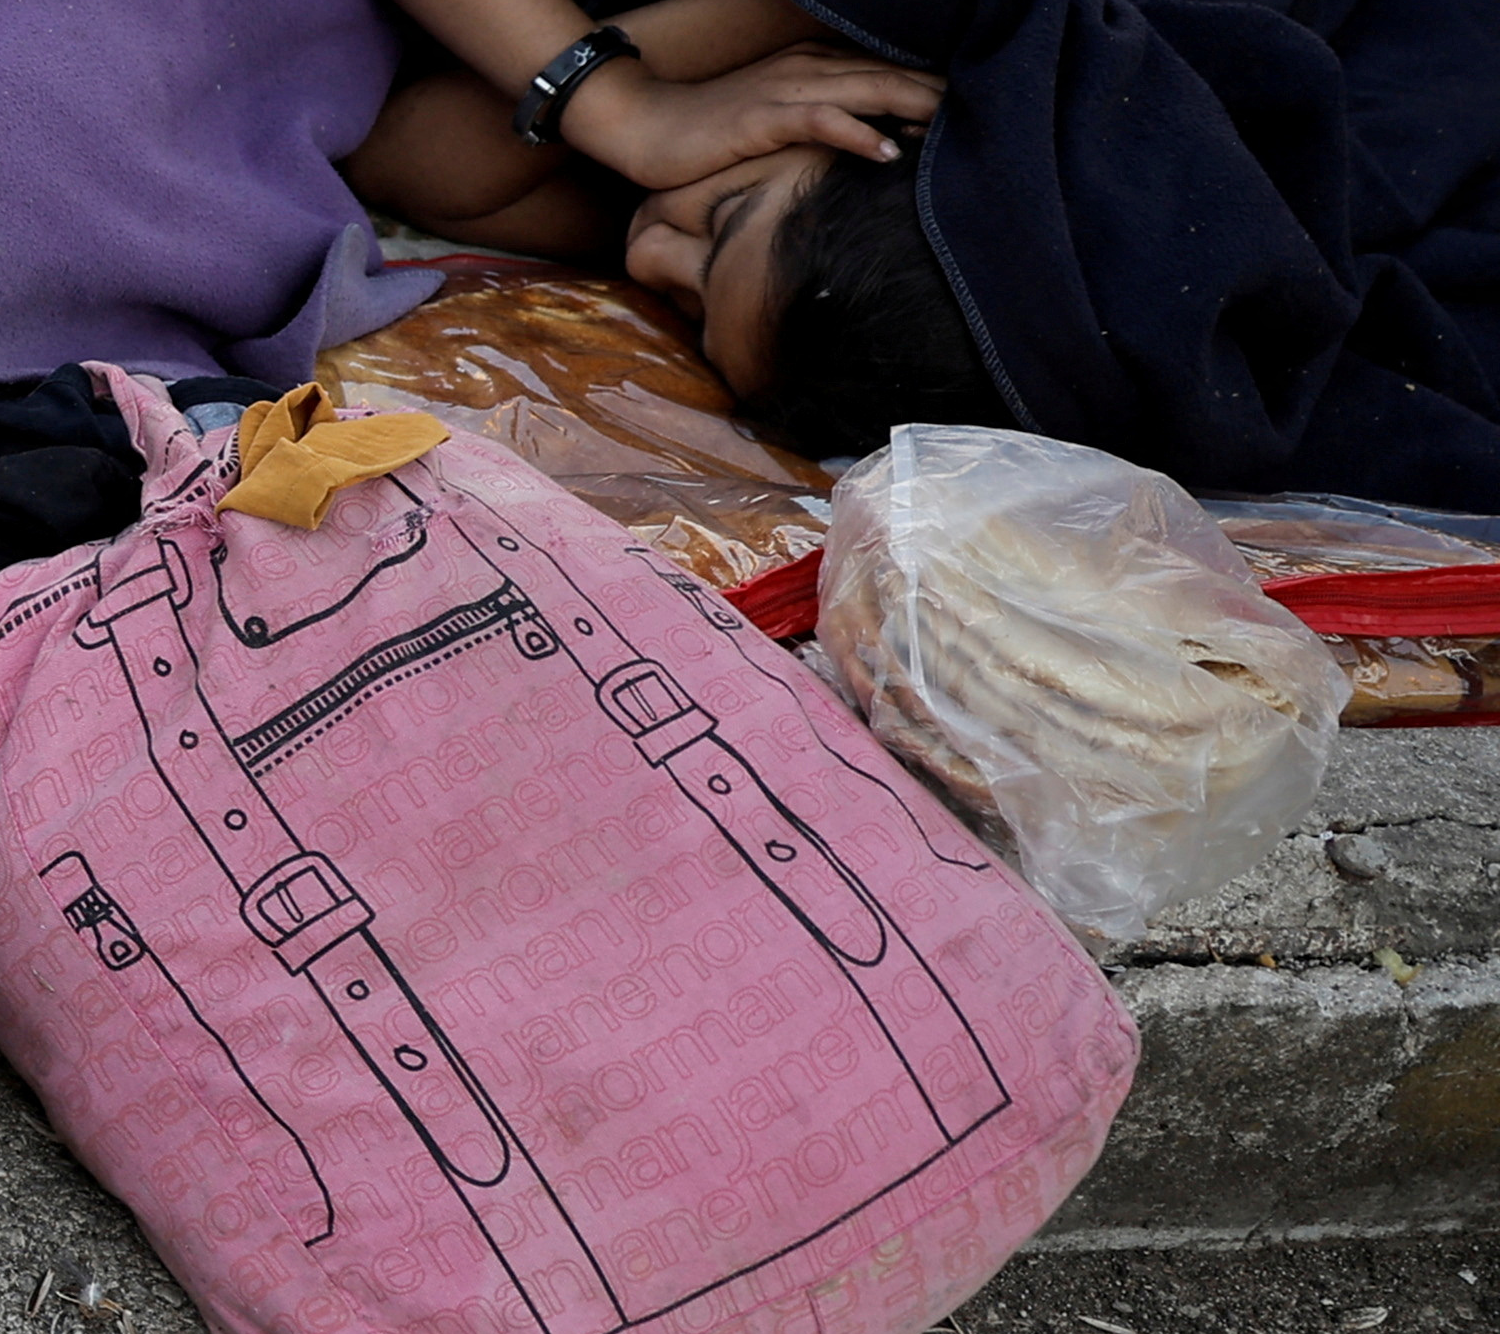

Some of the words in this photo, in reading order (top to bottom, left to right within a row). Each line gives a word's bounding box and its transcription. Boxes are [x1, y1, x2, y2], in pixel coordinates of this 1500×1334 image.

[230, 716, 370, 866] jane
[416, 777, 559, 911] jane
[444, 774, 715, 941] norman
[328, 909, 624, 1077] norman
[611, 831, 748, 970] jane
[501, 973, 656, 1110] jane
[539, 961, 822, 1138] norman
[417, 1113, 723, 1276] norman
[711, 1029, 860, 1183] jane
[591, 1188, 752, 1326] jane
[743, 1021, 1011, 1216] norman
